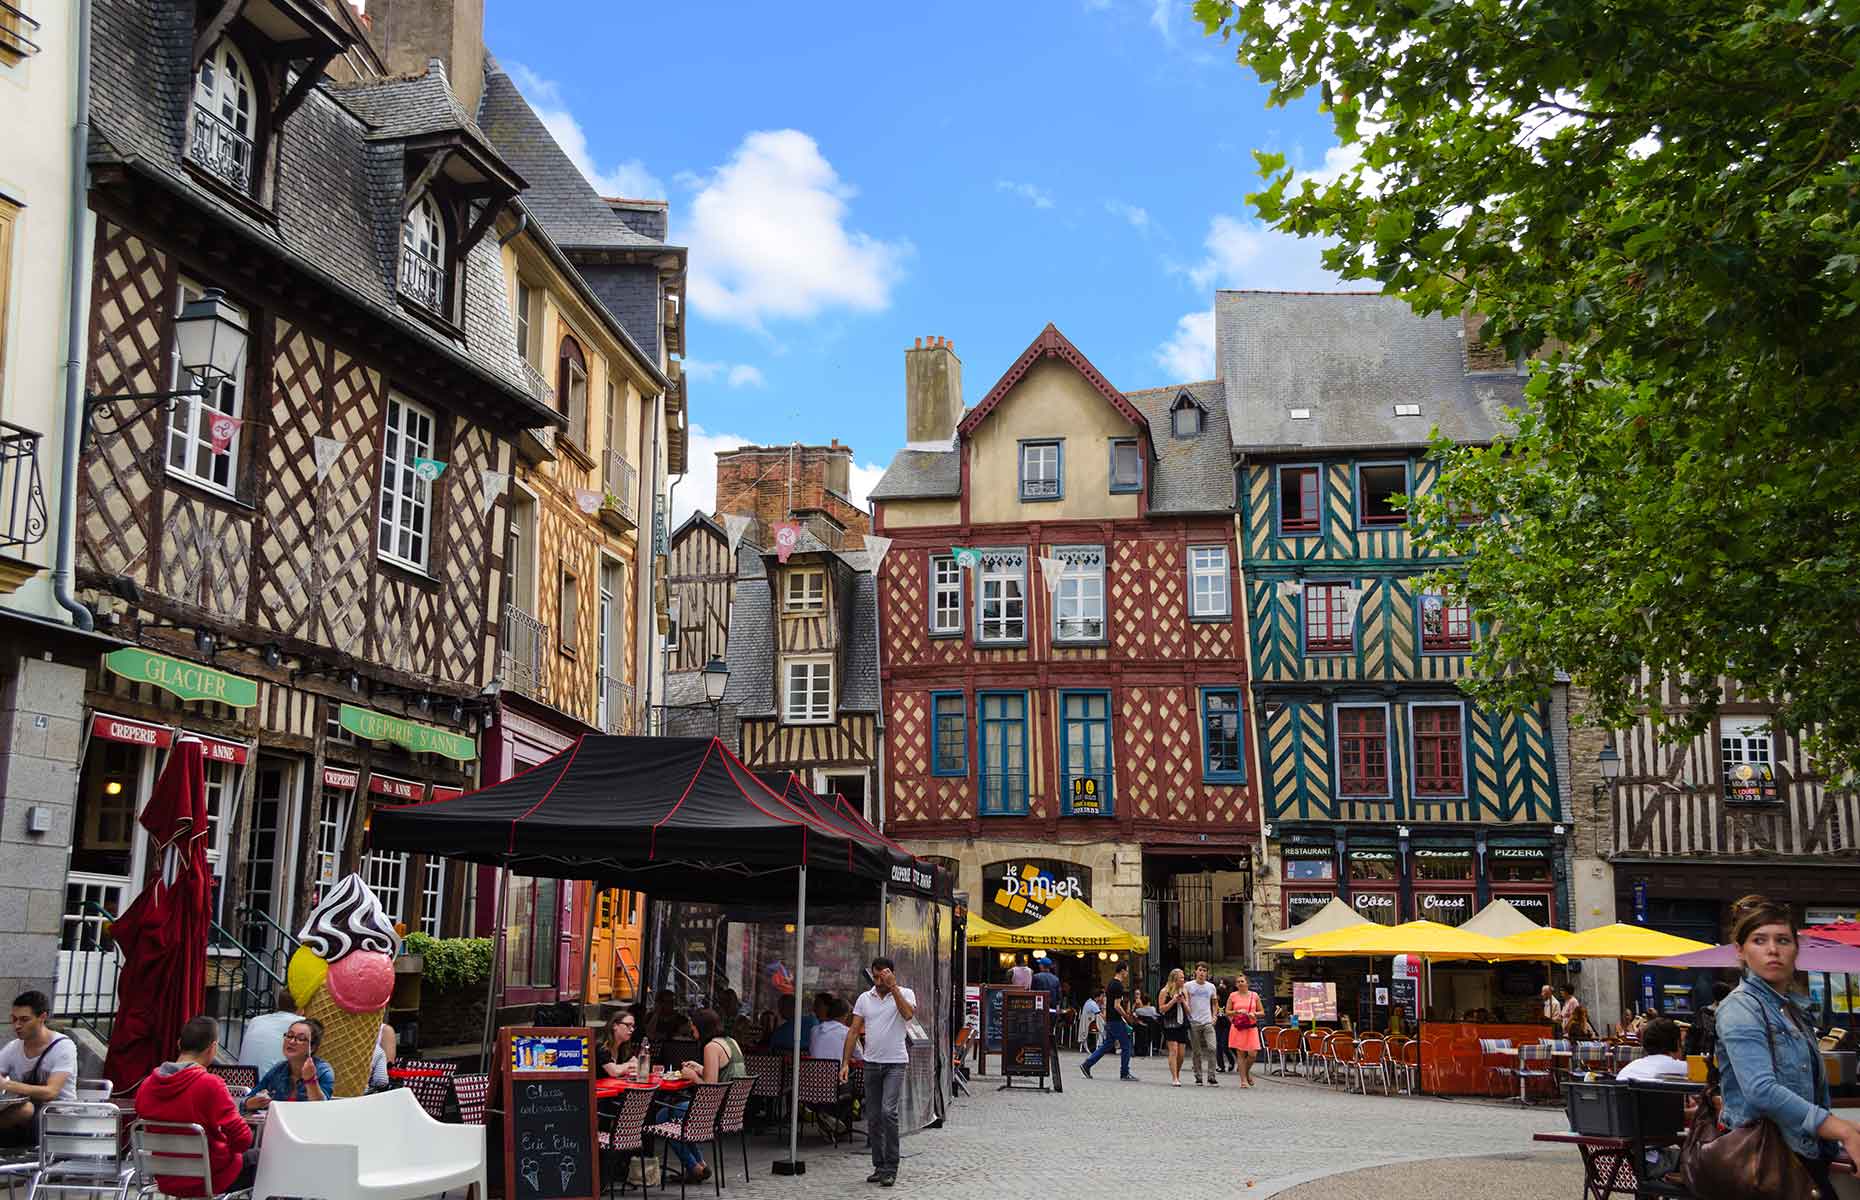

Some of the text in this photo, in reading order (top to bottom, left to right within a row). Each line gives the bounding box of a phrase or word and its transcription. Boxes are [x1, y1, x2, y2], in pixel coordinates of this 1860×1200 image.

[145, 657, 226, 697] GLACIER
[212, 743, 235, 761] ANNE
[395, 783, 412, 797] ANNE
[1284, 847, 1332, 856] RESTAURANT
[1495, 849, 1544, 857] PIZZERIA
[1006, 863, 1018, 877] le
[1026, 901, 1039, 912] BAR
[1356, 894, 1393, 908] Côte
[1424, 895, 1465, 909] Ouest
[1010, 935, 1112, 945] BAR BRASSERIE
